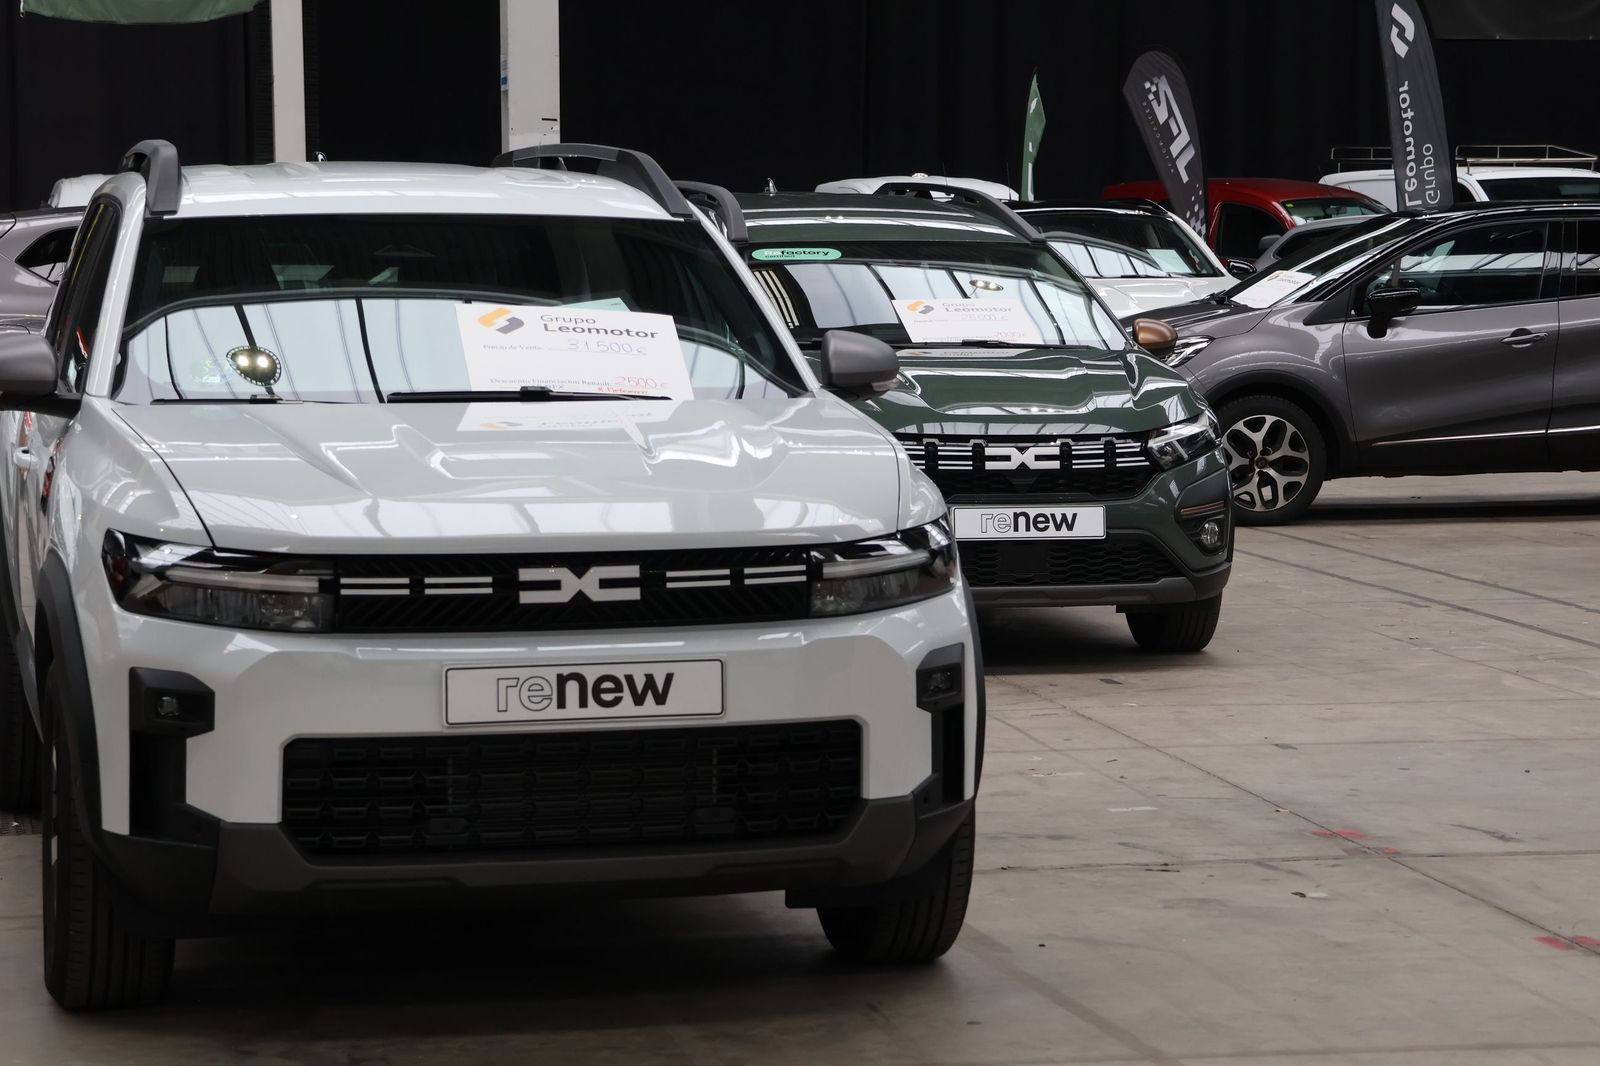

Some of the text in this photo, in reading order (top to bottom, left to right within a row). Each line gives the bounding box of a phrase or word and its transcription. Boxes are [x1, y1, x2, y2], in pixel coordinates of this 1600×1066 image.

[540, 314, 597, 325] Grupo
[543, 323, 659, 339] Leomotor
[981, 511, 1078, 533] renew
[497, 672, 675, 712] renew
